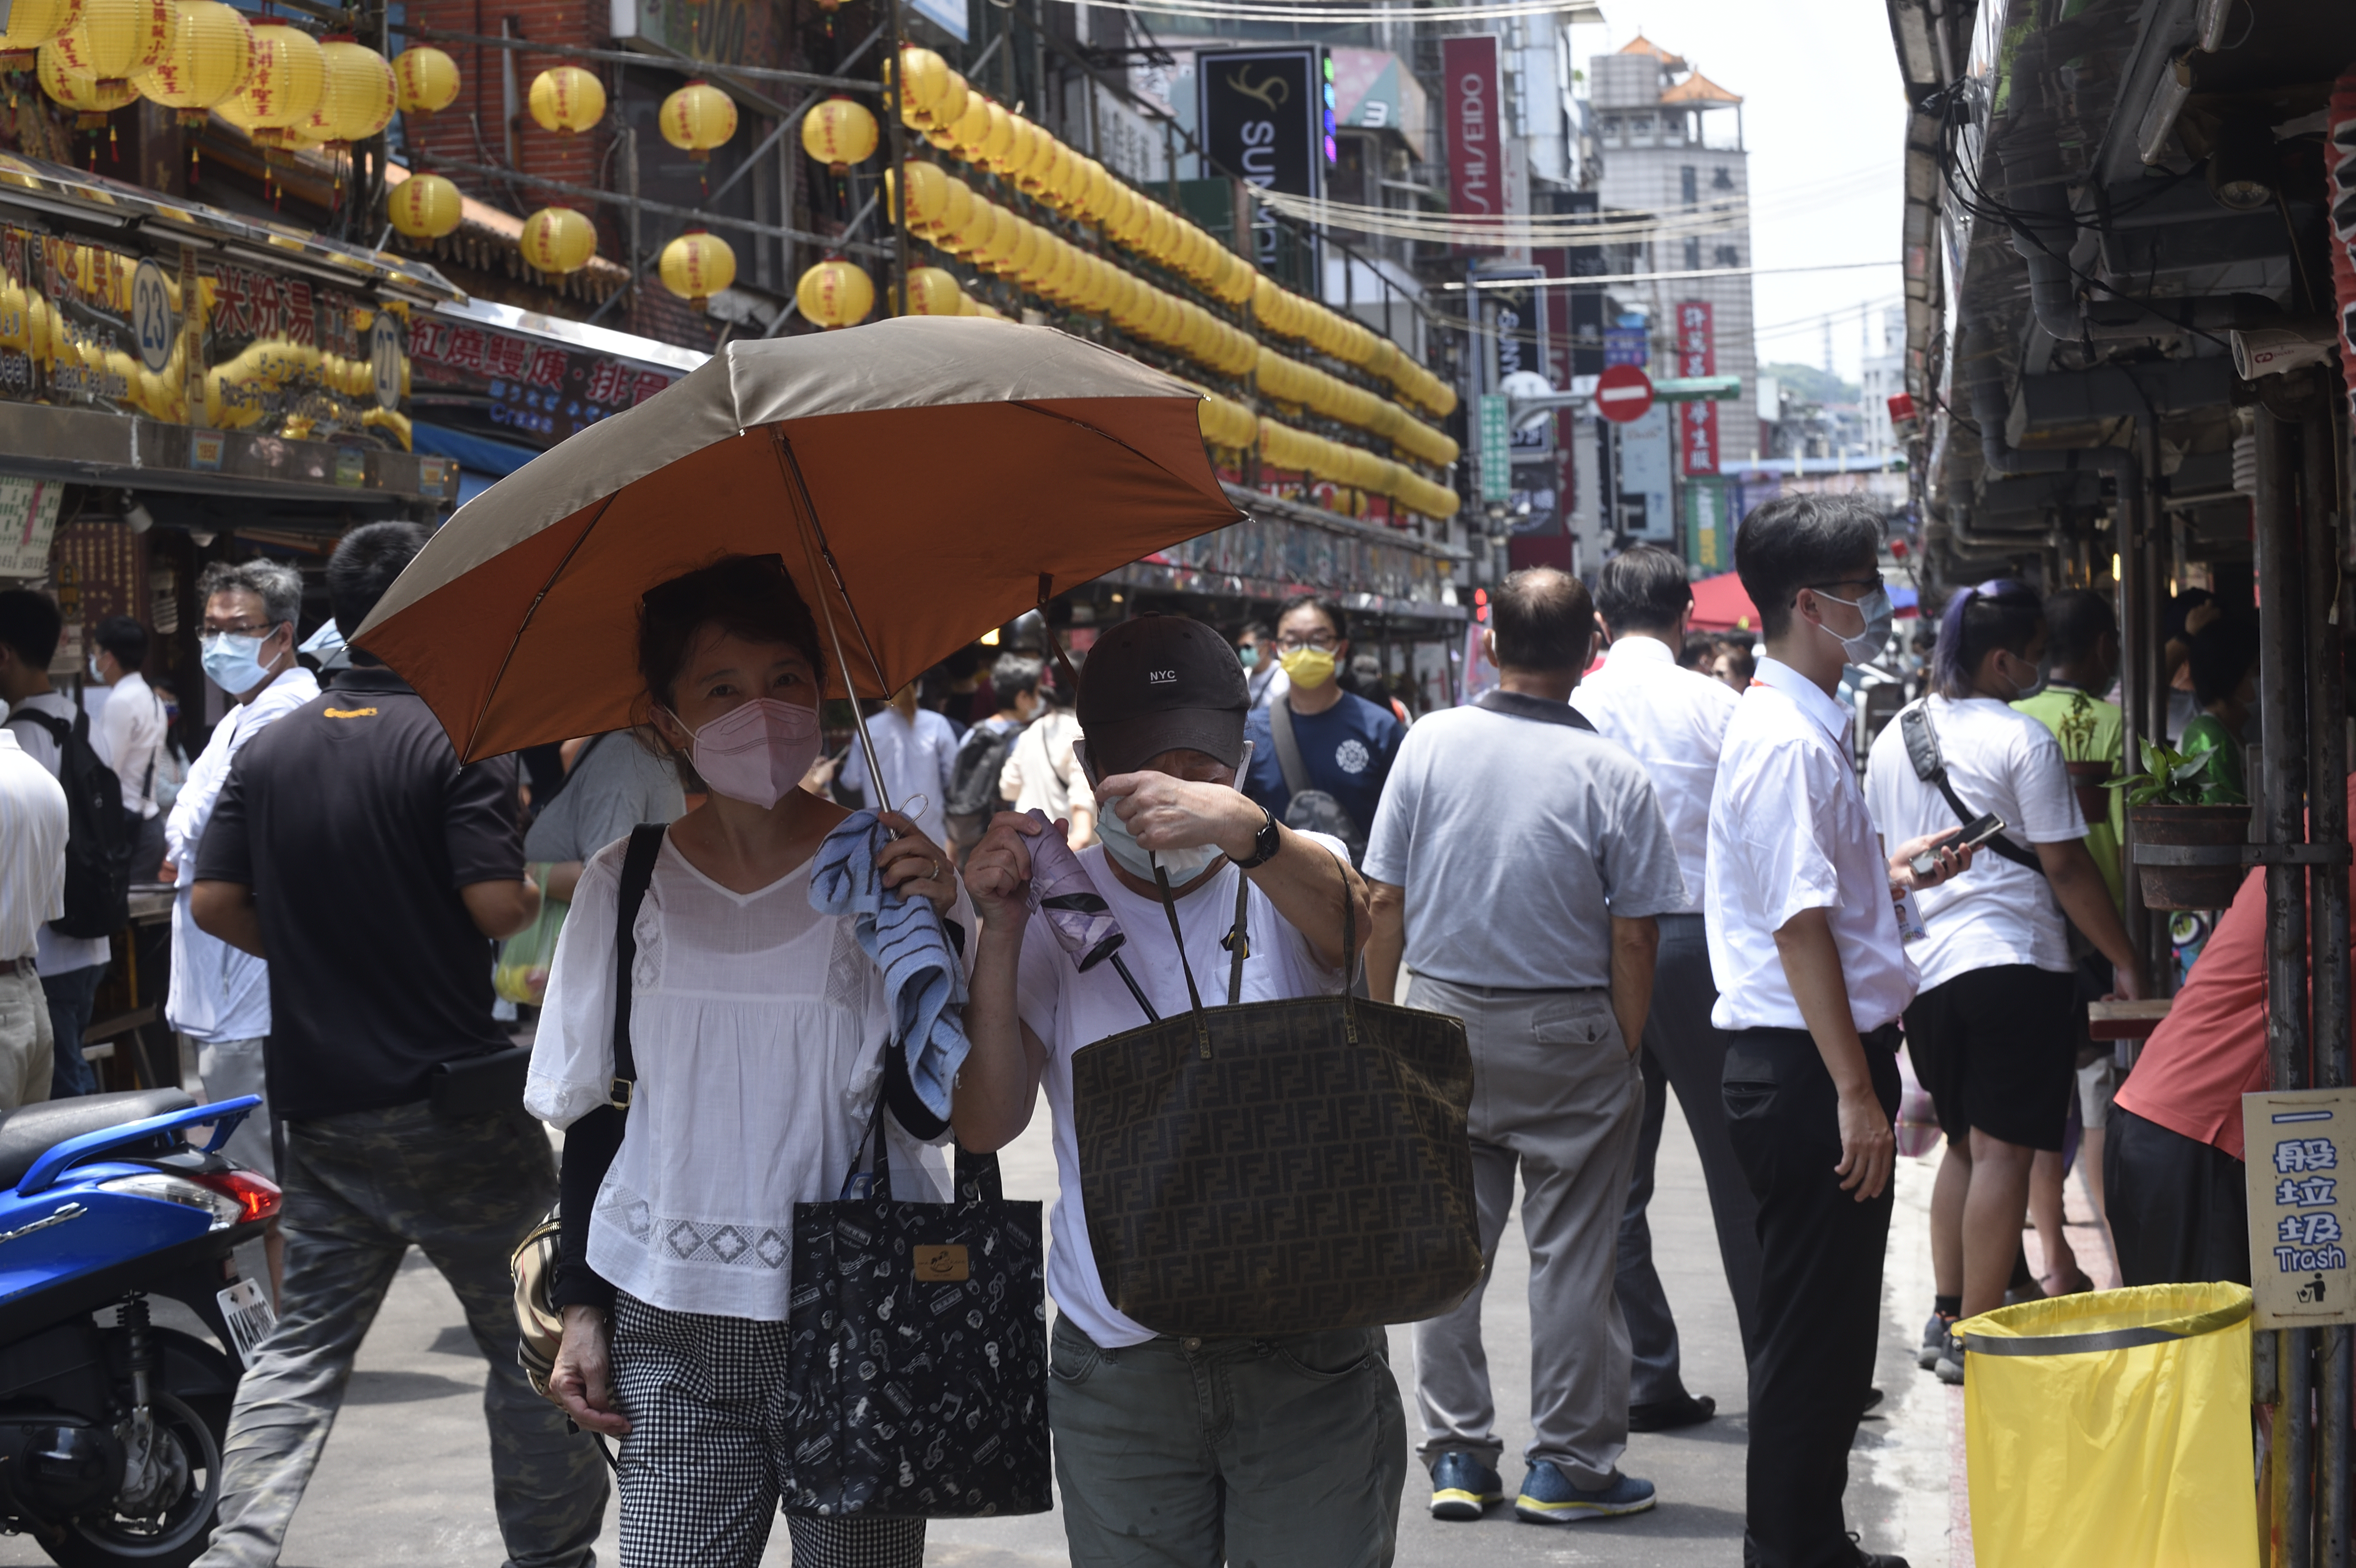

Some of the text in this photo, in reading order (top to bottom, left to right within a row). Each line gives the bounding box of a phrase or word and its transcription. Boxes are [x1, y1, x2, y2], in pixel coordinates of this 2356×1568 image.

[1461, 74, 1491, 215] SHISEIDO
[139, 278, 165, 351] 23
[214, 263, 316, 348] 米粉湯
[489, 403, 555, 434] Crabs
[1149, 670, 1177, 681] NYC
[2271, 1110, 2342, 1246] 一般垃圾
[2273, 1243, 2346, 1273] Trash
